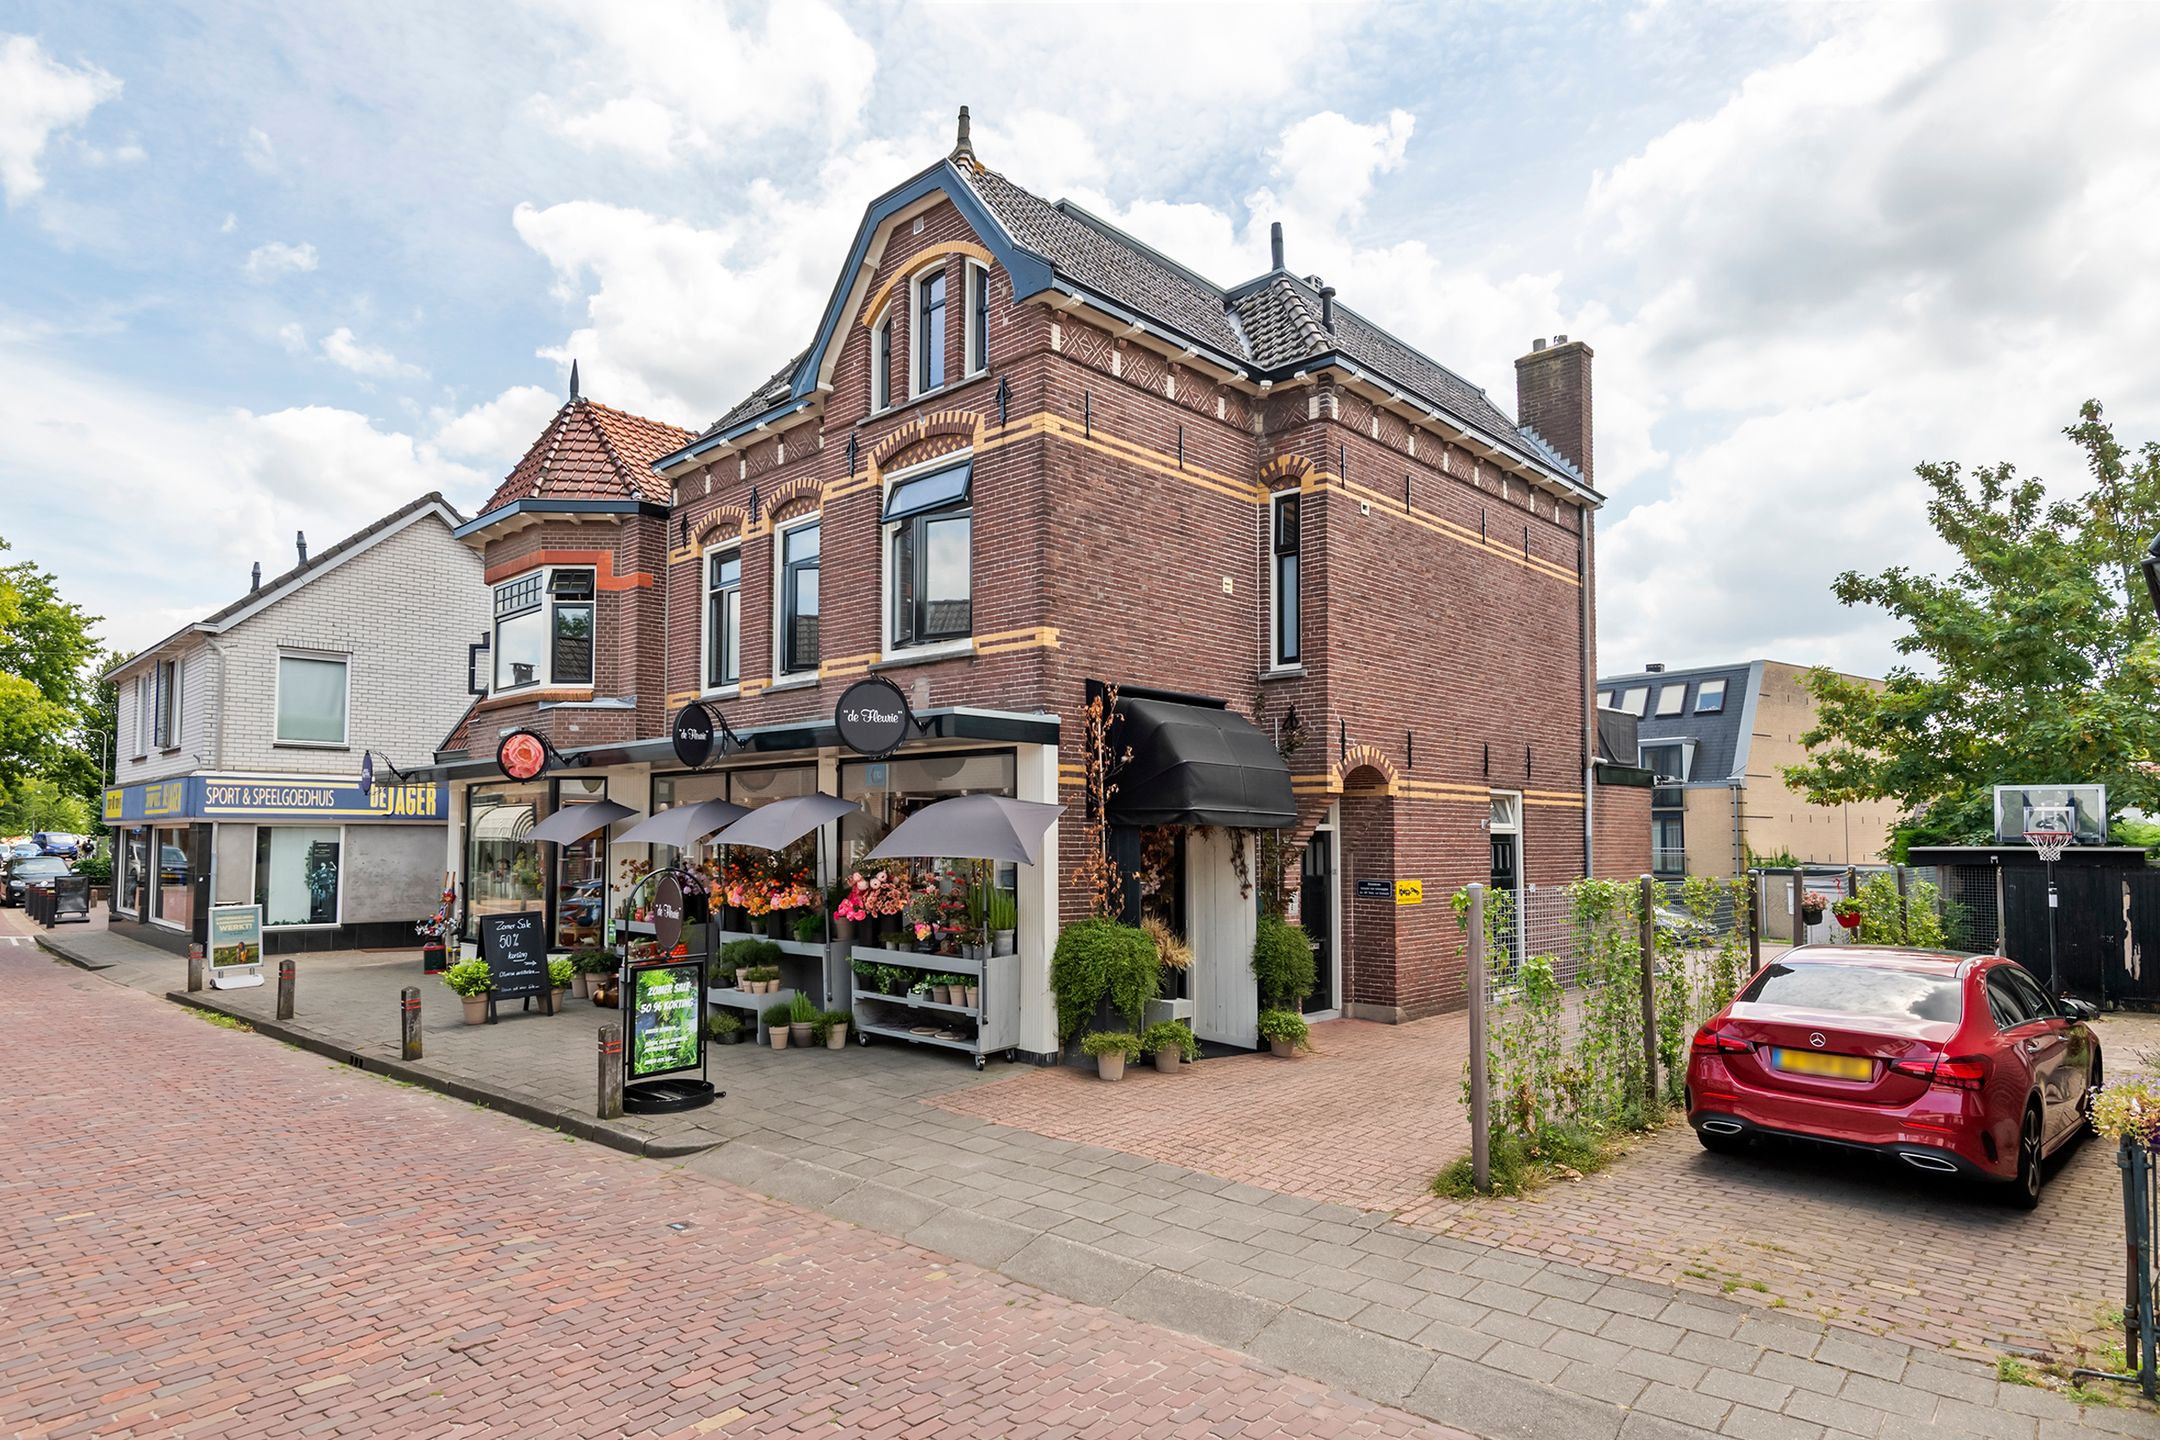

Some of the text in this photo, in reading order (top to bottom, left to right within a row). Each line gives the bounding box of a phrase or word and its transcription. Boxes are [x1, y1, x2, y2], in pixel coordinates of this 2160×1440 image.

[206, 787, 335, 806] SPORT & SPEELGOEDHUIS
[387, 782, 437, 816] JAGER
[640, 1003, 652, 1014] 50
[663, 998, 694, 1011] KORTING
